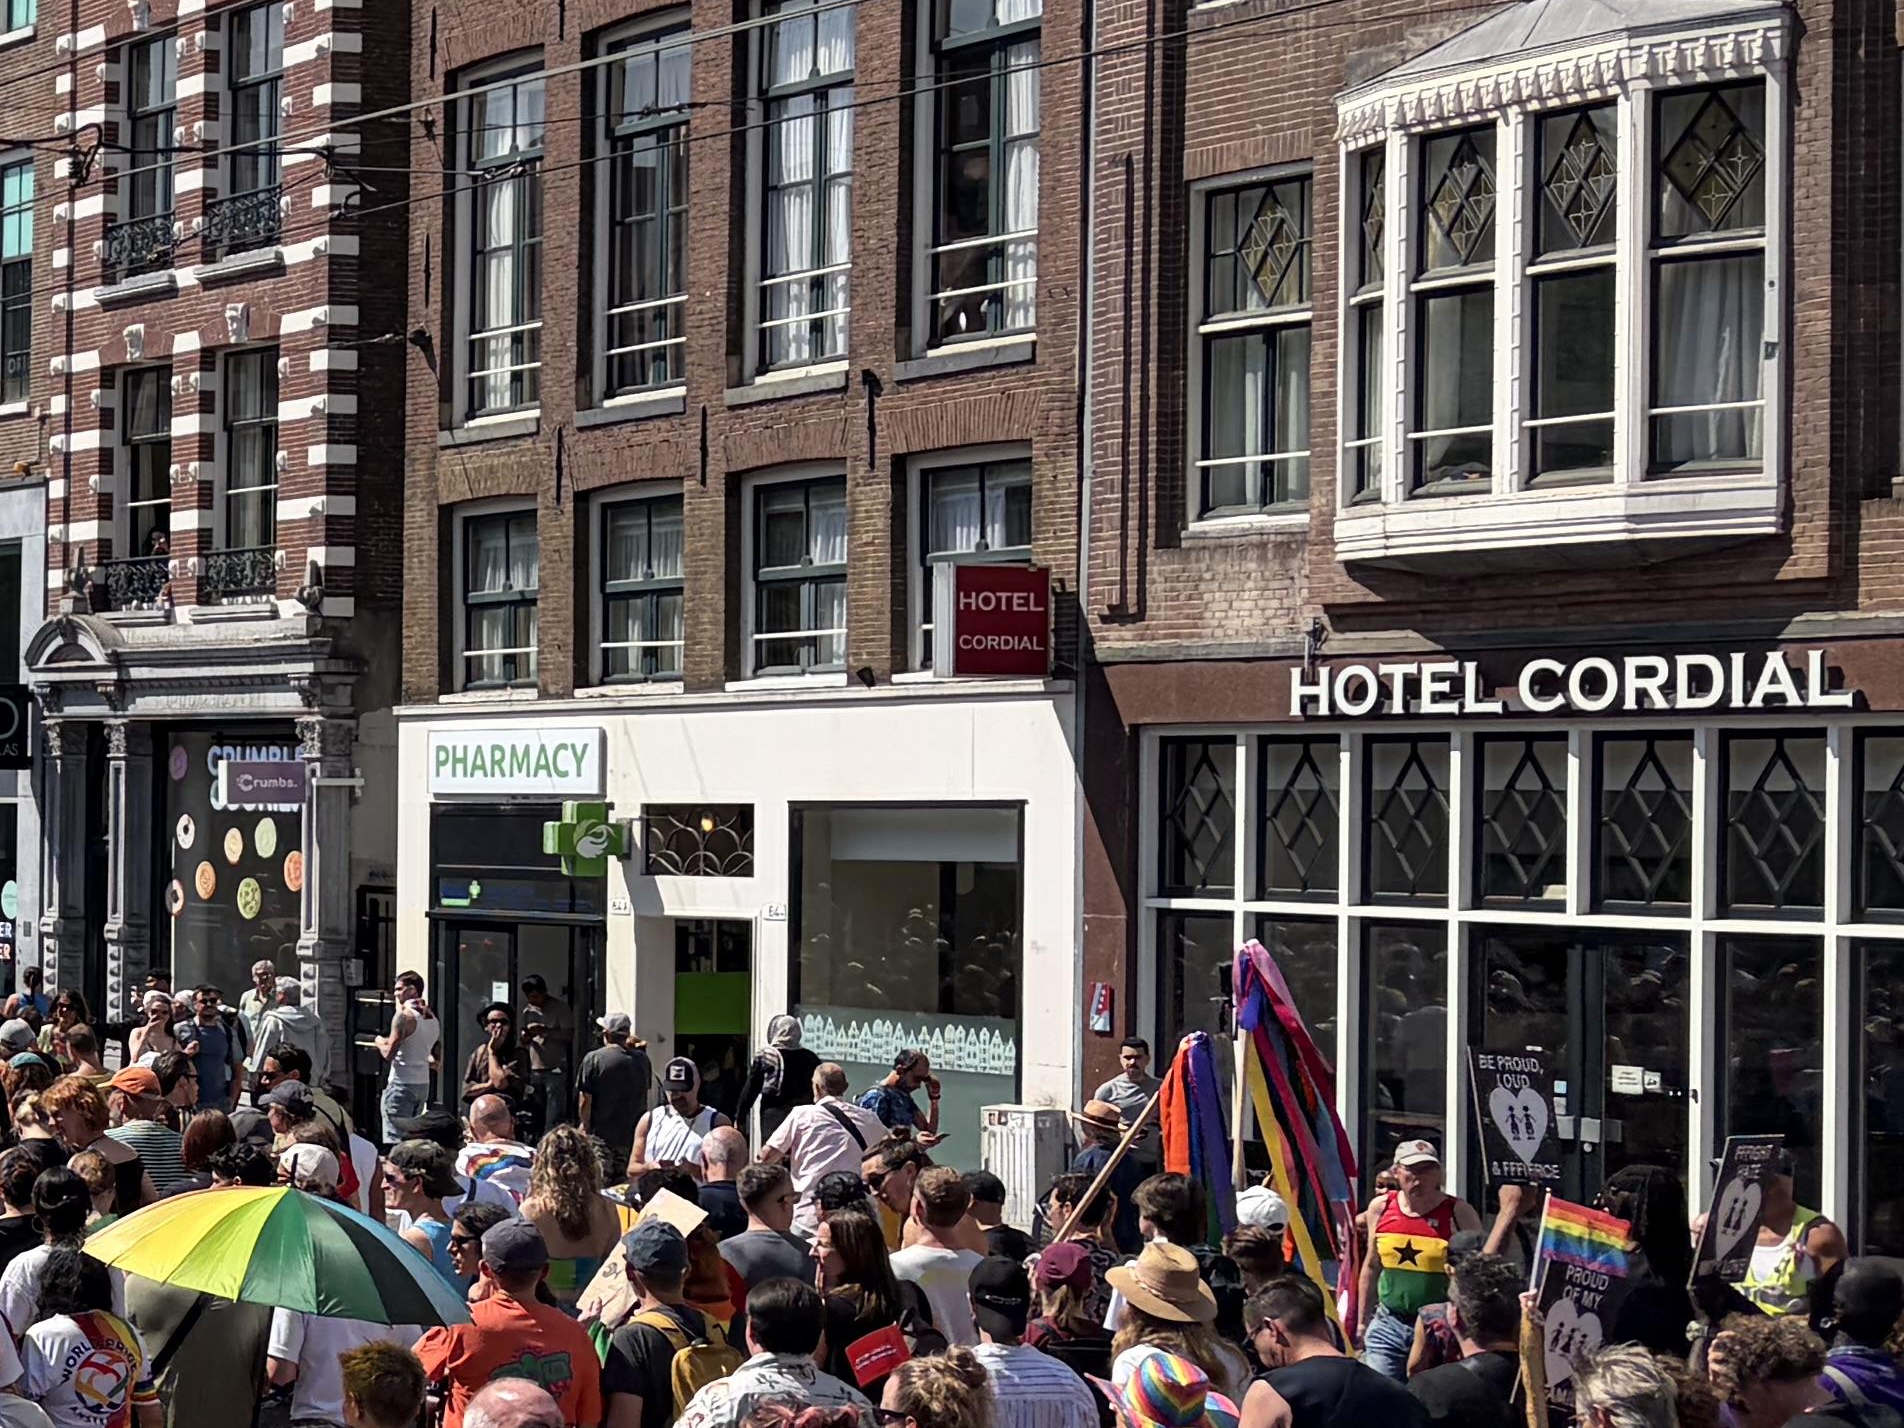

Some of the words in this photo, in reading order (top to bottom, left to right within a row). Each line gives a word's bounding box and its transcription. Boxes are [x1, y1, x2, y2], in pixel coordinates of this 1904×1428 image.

[959, 591, 1045, 612] HOTEL
[959, 634, 1045, 651] CORDIAL
[1289, 660, 1504, 717] HOTEL
[1518, 649, 1854, 713] CORDIAL
[435, 743, 590, 779] PHARMACY
[1478, 1054, 1496, 1070] BE
[1497, 1055, 1544, 1075] PROUD,
[1496, 1073, 1530, 1089] LOUD
[1566, 1264, 1610, 1291] PROUD
[1563, 1285, 1581, 1302] OF
[1582, 1290, 1605, 1310] MY
